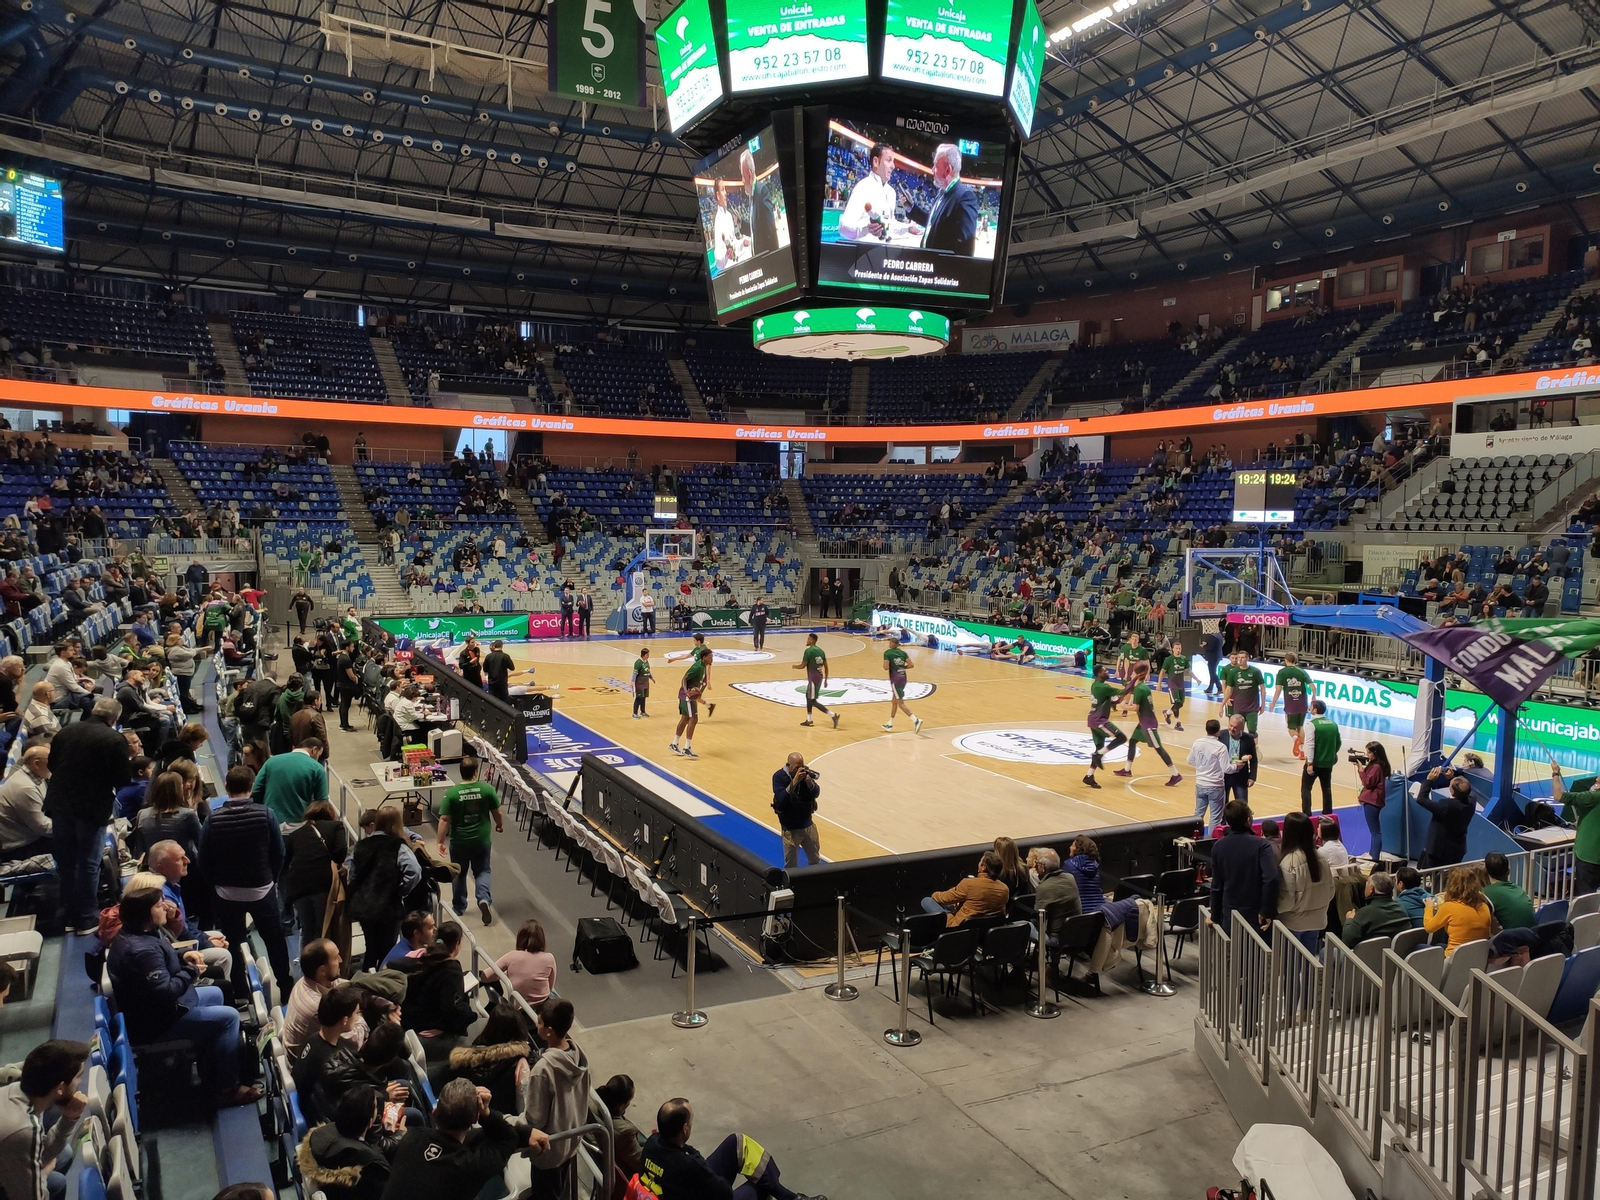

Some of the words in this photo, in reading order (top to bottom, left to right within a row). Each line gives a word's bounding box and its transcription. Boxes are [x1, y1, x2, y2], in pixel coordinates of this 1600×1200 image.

[780, 3, 813, 16] Unicaja
[938, 7, 967, 22] Unicaja
[581, 0, 615, 58] 5
[747, 24, 778, 37] VENTA
[780, 21, 793, 33] DE
[794, 14, 846, 31] ENTRADAS
[905, 16, 934, 31] VENTA
[935, 22, 947, 34] DE
[948, 24, 992, 43] ENTRADAS
[754, 55, 778, 70] 952
[783, 52, 799, 67] 23
[804, 50, 820, 65] 57
[825, 47, 841, 61] 08
[906, 48, 929, 65] 952
[933, 53, 948, 68] 23
[952, 56, 966, 71] 57
[970, 60, 984, 75] 08
[741, 63, 846, 82] www.uncajabalonesto.com
[893, 63, 986, 85] www.uncajabalonesto.com
[576, 84, 594, 95] 1999
[603, 89, 621, 100] 2012
[906, 118, 949, 134] MONDO
[883, 259, 905, 270] PEDRO
[905, 261, 934, 273] CABRERA
[854, 269, 883, 280] Presidente
[883, 271, 890, 281] de
[890, 272, 918, 283] Asociación
[918, 275, 933, 286] Zapas
[934, 276, 959, 287] Solidarias
[971, 334, 1007, 352] 2020
[1011, 328, 1070, 344] MÁLAGA
[152, 396, 219, 410] Gráficas
[224, 400, 278, 414] Urania
[1213, 406, 1265, 420] Gráficas
[1268, 400, 1315, 415] Urania
[473, 415, 527, 427] Gráficas
[531, 418, 574, 430] Urania
[983, 426, 1030, 437] Gráficas
[1033, 423, 1069, 435] Urania
[735, 428, 783, 438] Gráficas
[786, 429, 827, 439] Urania
[1238, 473, 1266, 485] 19:24
[1270, 473, 1296, 485] 19:24
[711, 618, 736, 627] Unicaja
[879, 615, 903, 629] VENTA
[903, 617, 914, 631] DE
[915, 620, 958, 638] ENTRADAS
[1243, 614, 1285, 626] endesa
[461, 629, 518, 637] uniajabaloncesto
[1450, 630, 1513, 674] FONDO
[522, 708, 550, 718] SPALDING
[996, 733, 1092, 760] PEDRIZAS
[644, 1157, 665, 1178] TÉCNICO
